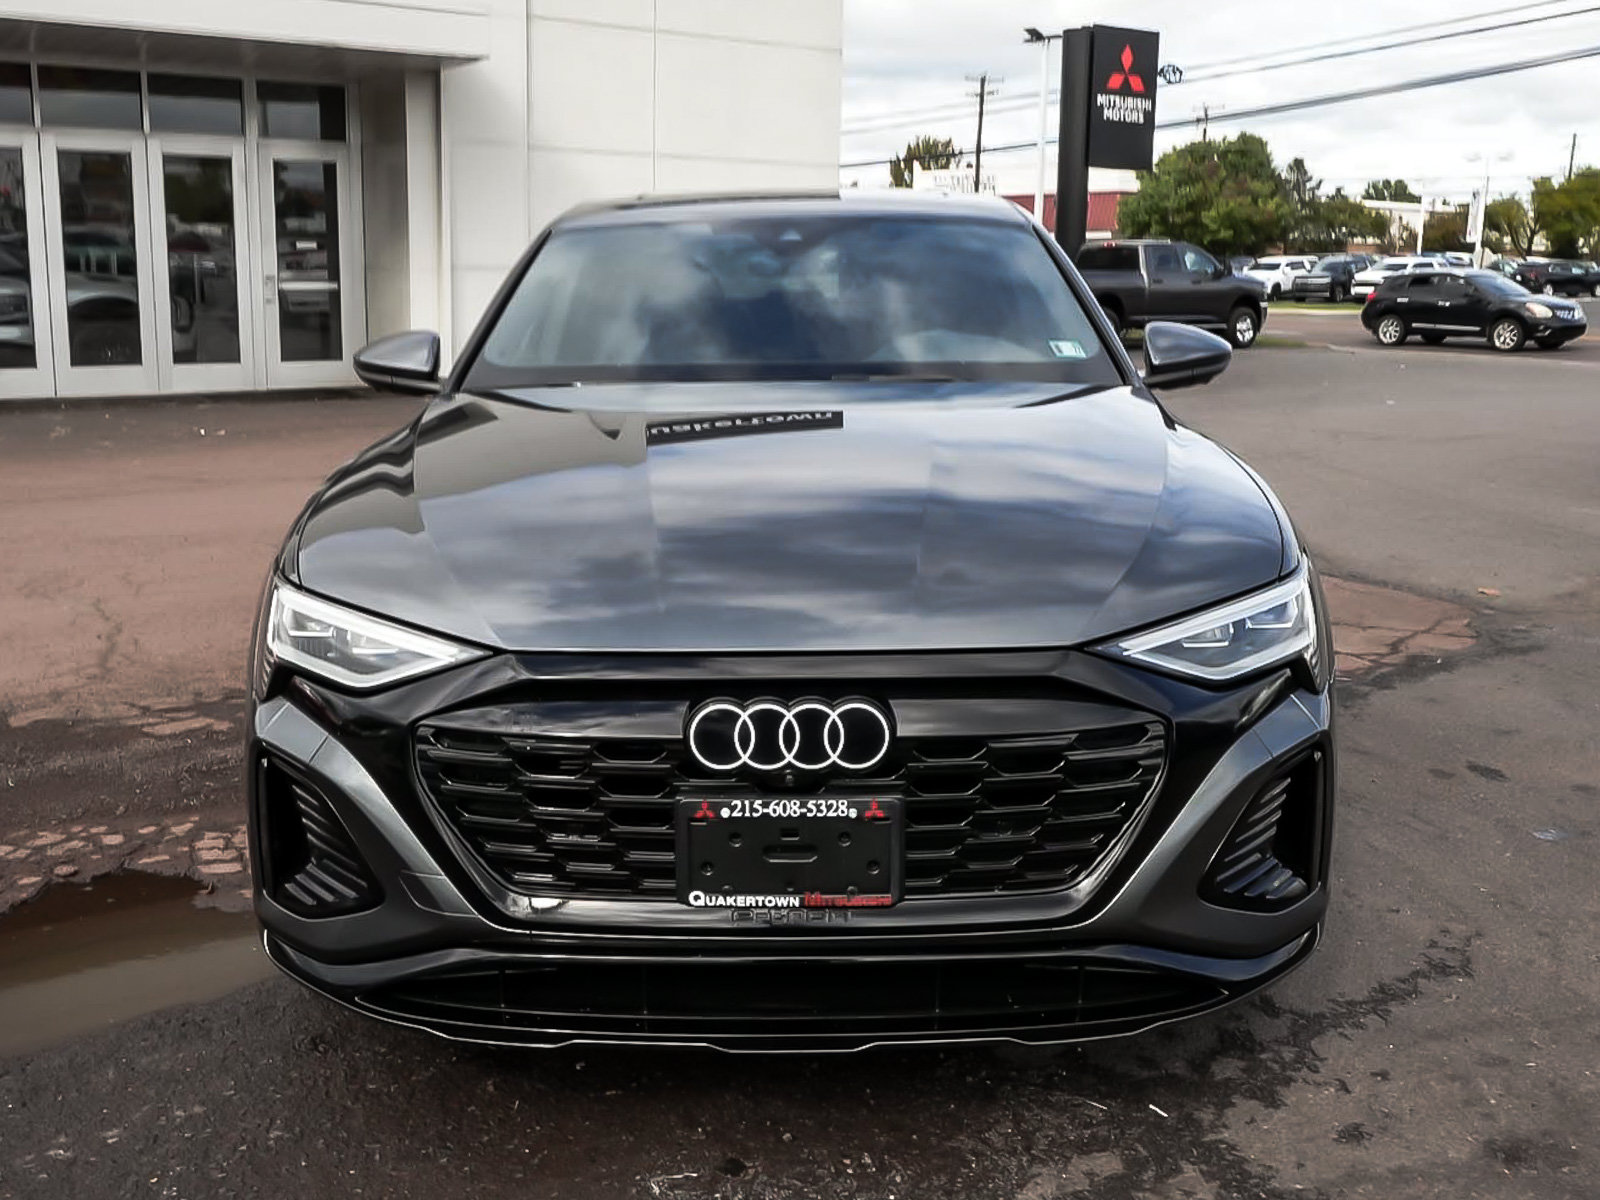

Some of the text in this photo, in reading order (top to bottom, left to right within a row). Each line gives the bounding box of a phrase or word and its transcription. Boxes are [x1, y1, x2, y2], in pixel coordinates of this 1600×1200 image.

[1097, 93, 1152, 112] MITSUBISHI
[1103, 107, 1144, 124] MOTORS
[731, 800, 848, 817] 215-608-5328
